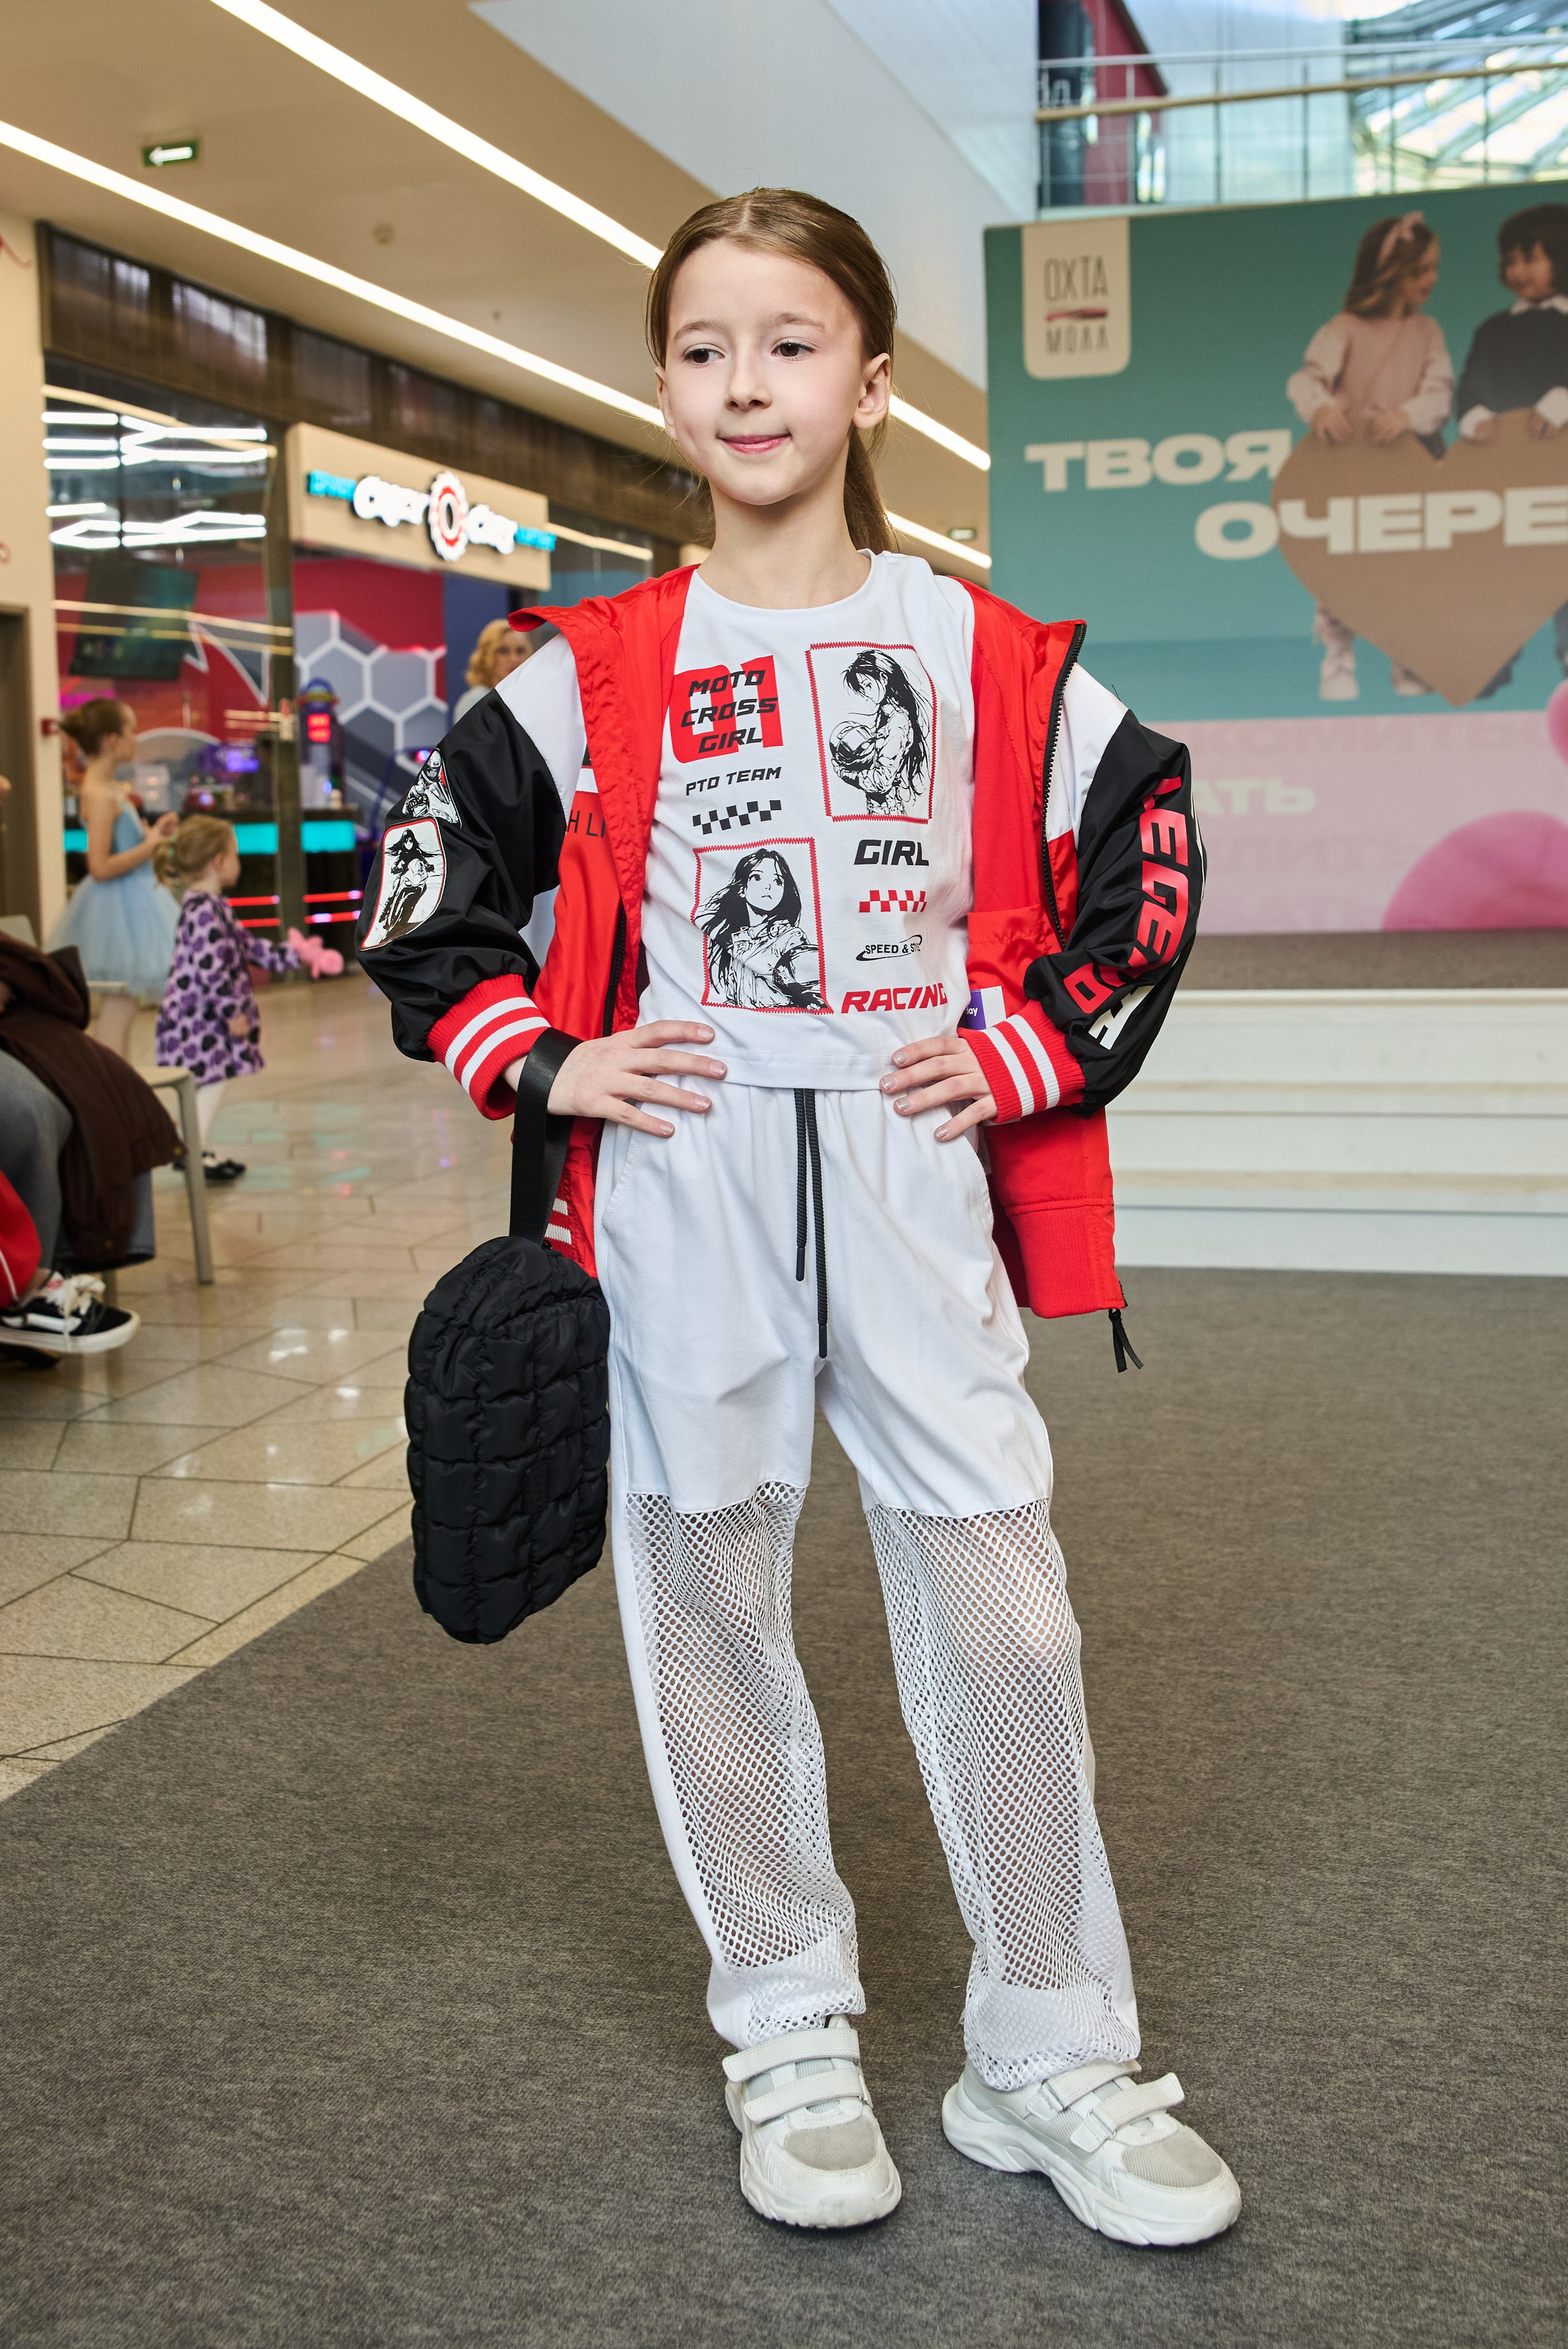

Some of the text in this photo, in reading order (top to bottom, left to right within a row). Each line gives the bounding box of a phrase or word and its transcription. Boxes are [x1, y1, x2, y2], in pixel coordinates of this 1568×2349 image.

[1044, 255, 1109, 302] ОХТА
[1024, 429, 1292, 491] ТВОЯ
[688, 670, 766, 697] MOTO
[680, 697, 778, 727] CROSS
[698, 727, 763, 754] GIRL
[686, 766, 782, 796] PTO TEAM
[854, 839, 929, 866] GIRL
[865, 944, 899, 954] SPEED
[902, 944, 909, 953] &
[842, 983, 948, 1013] RACING
